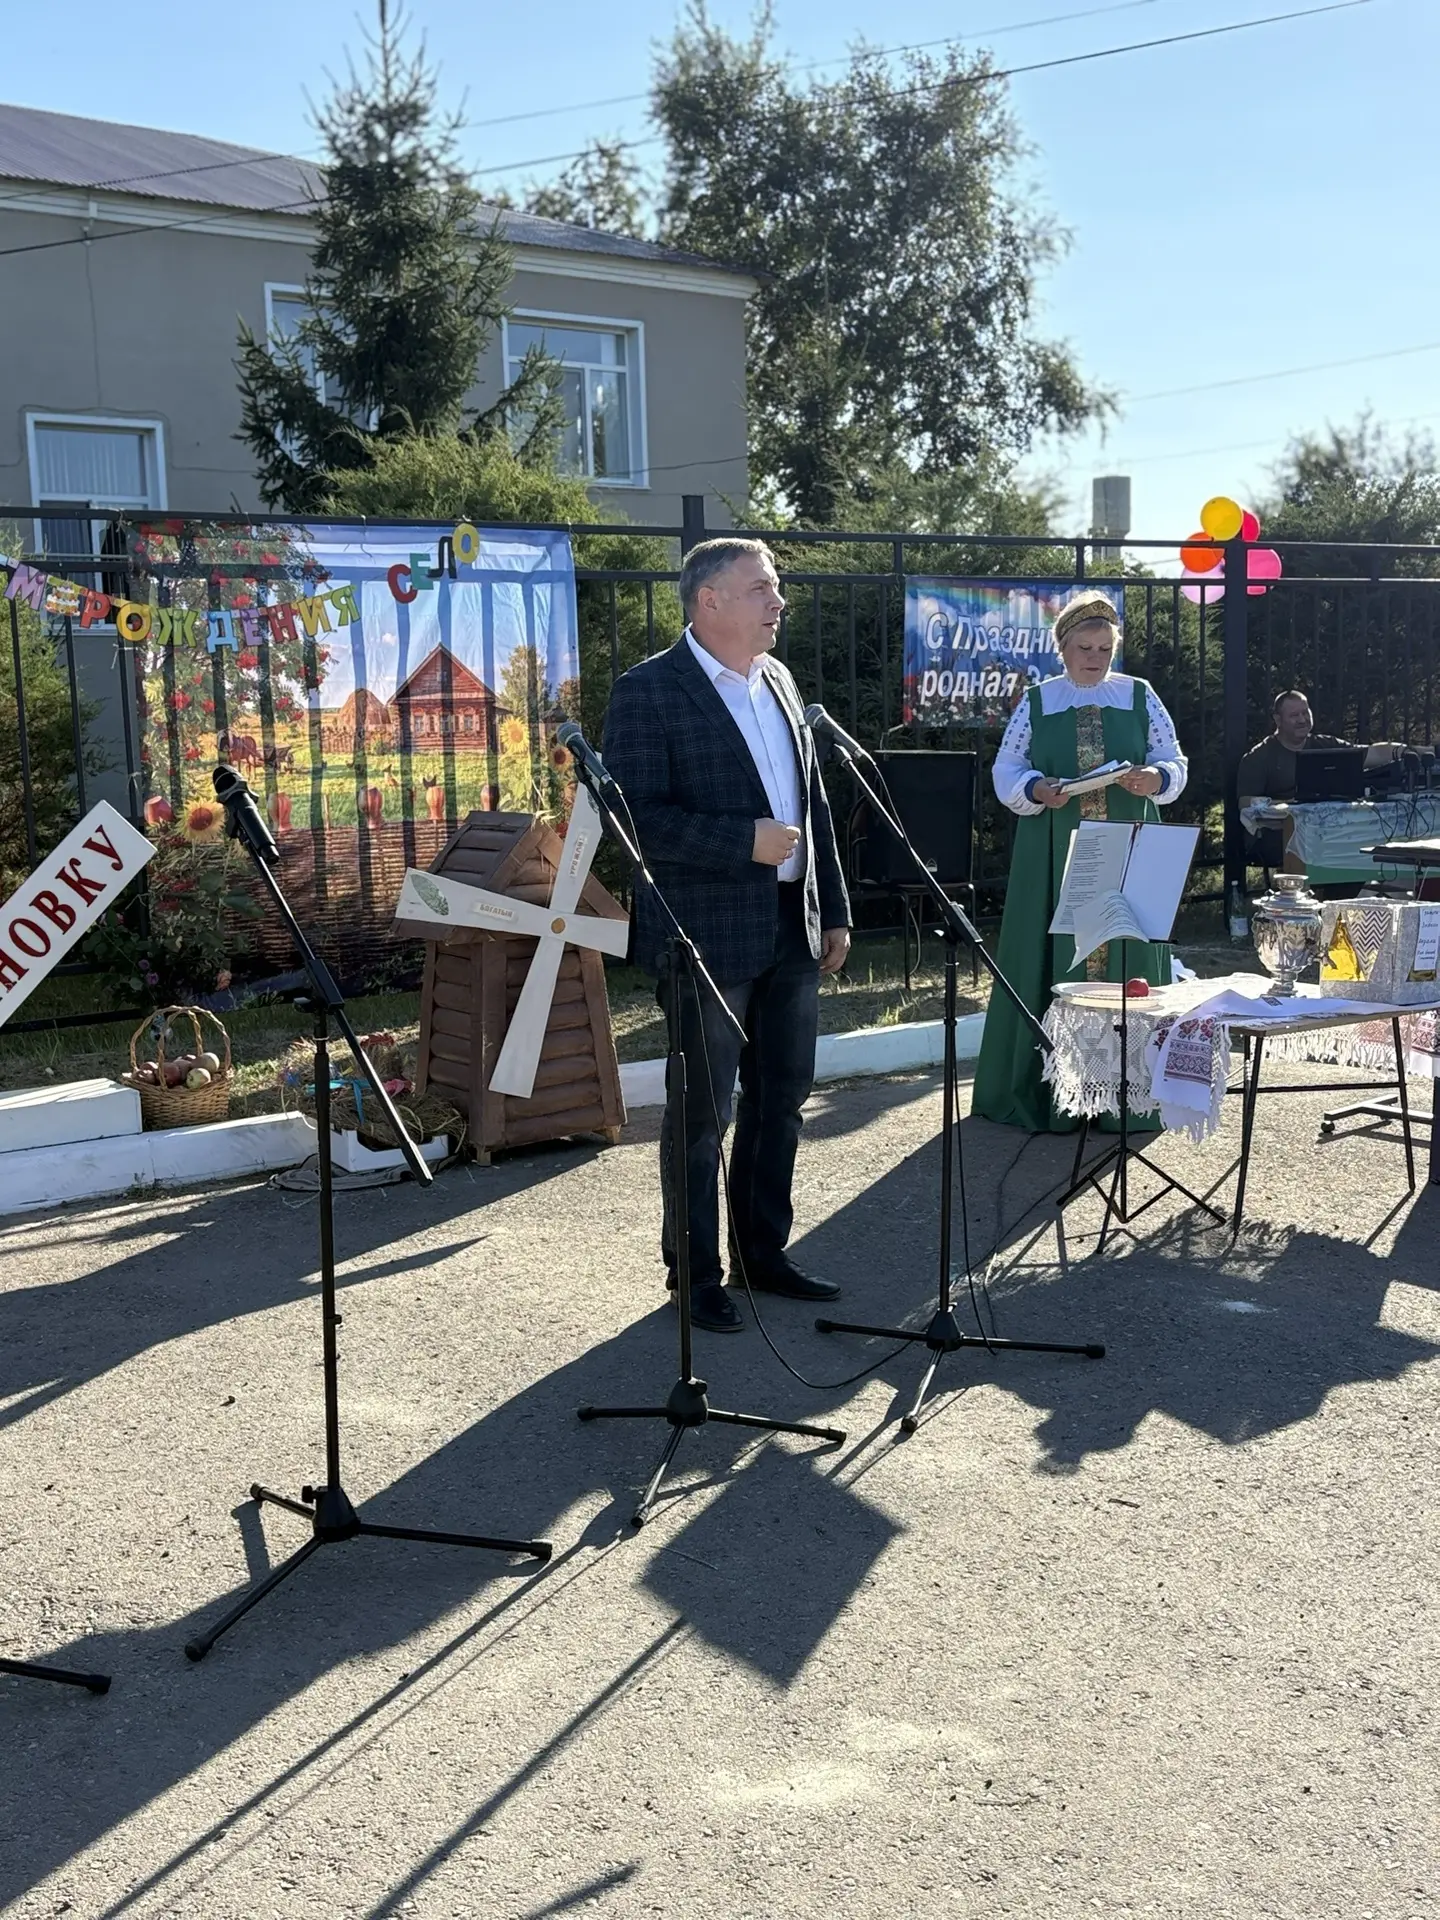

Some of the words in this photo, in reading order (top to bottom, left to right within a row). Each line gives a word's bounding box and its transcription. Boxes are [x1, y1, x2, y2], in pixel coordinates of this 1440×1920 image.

[387, 523, 480, 604] СЕЛО
[79, 585, 361, 653] РОЖДЕНИЯ
[926, 611, 949, 650] С
[951, 615, 1058, 659] Праздни
[920, 669, 1019, 706] родная
[0, 824, 123, 995] НОВКУ
